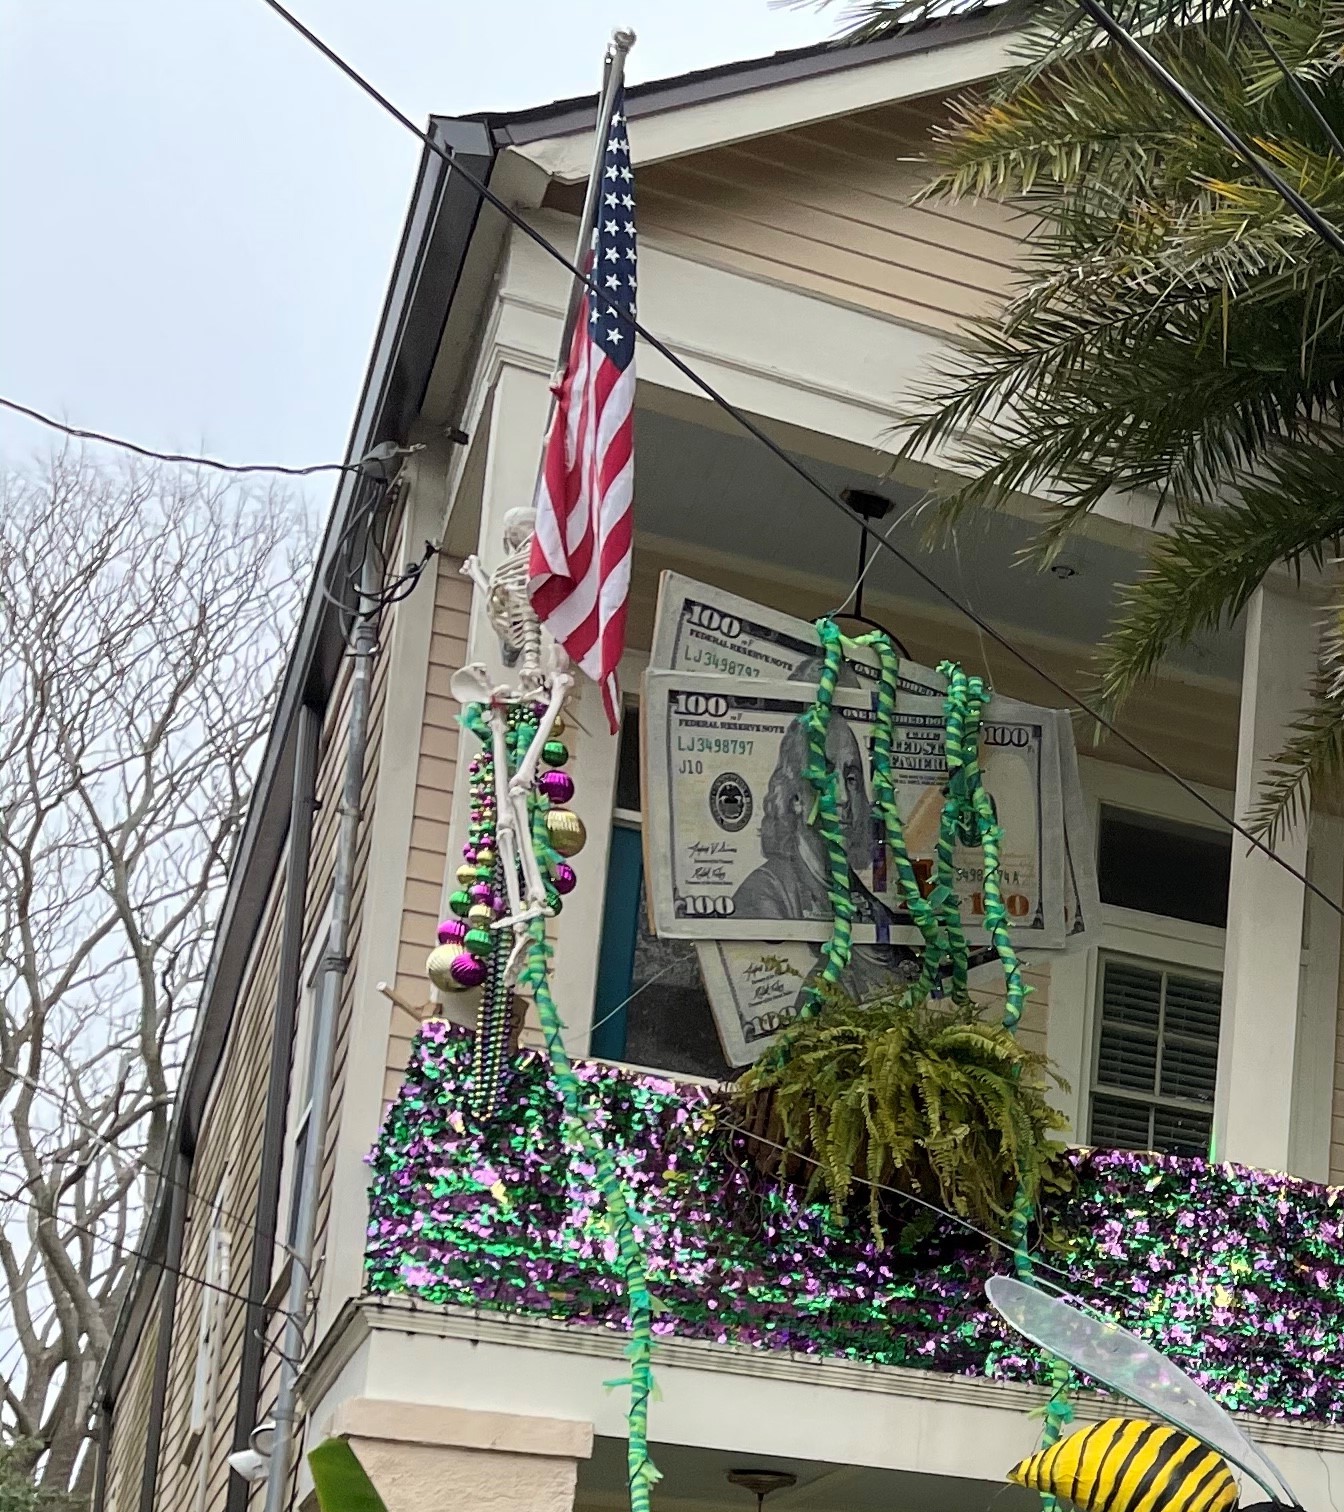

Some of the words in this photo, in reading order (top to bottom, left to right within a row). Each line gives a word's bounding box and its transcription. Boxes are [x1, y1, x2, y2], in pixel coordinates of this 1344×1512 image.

[687, 605, 742, 638] 100
[675, 694, 729, 717] 100
[677, 735, 754, 756] LJ3498797
[984, 726, 1030, 747] 100
[678, 759, 703, 775] J10
[684, 895, 736, 916] 100
